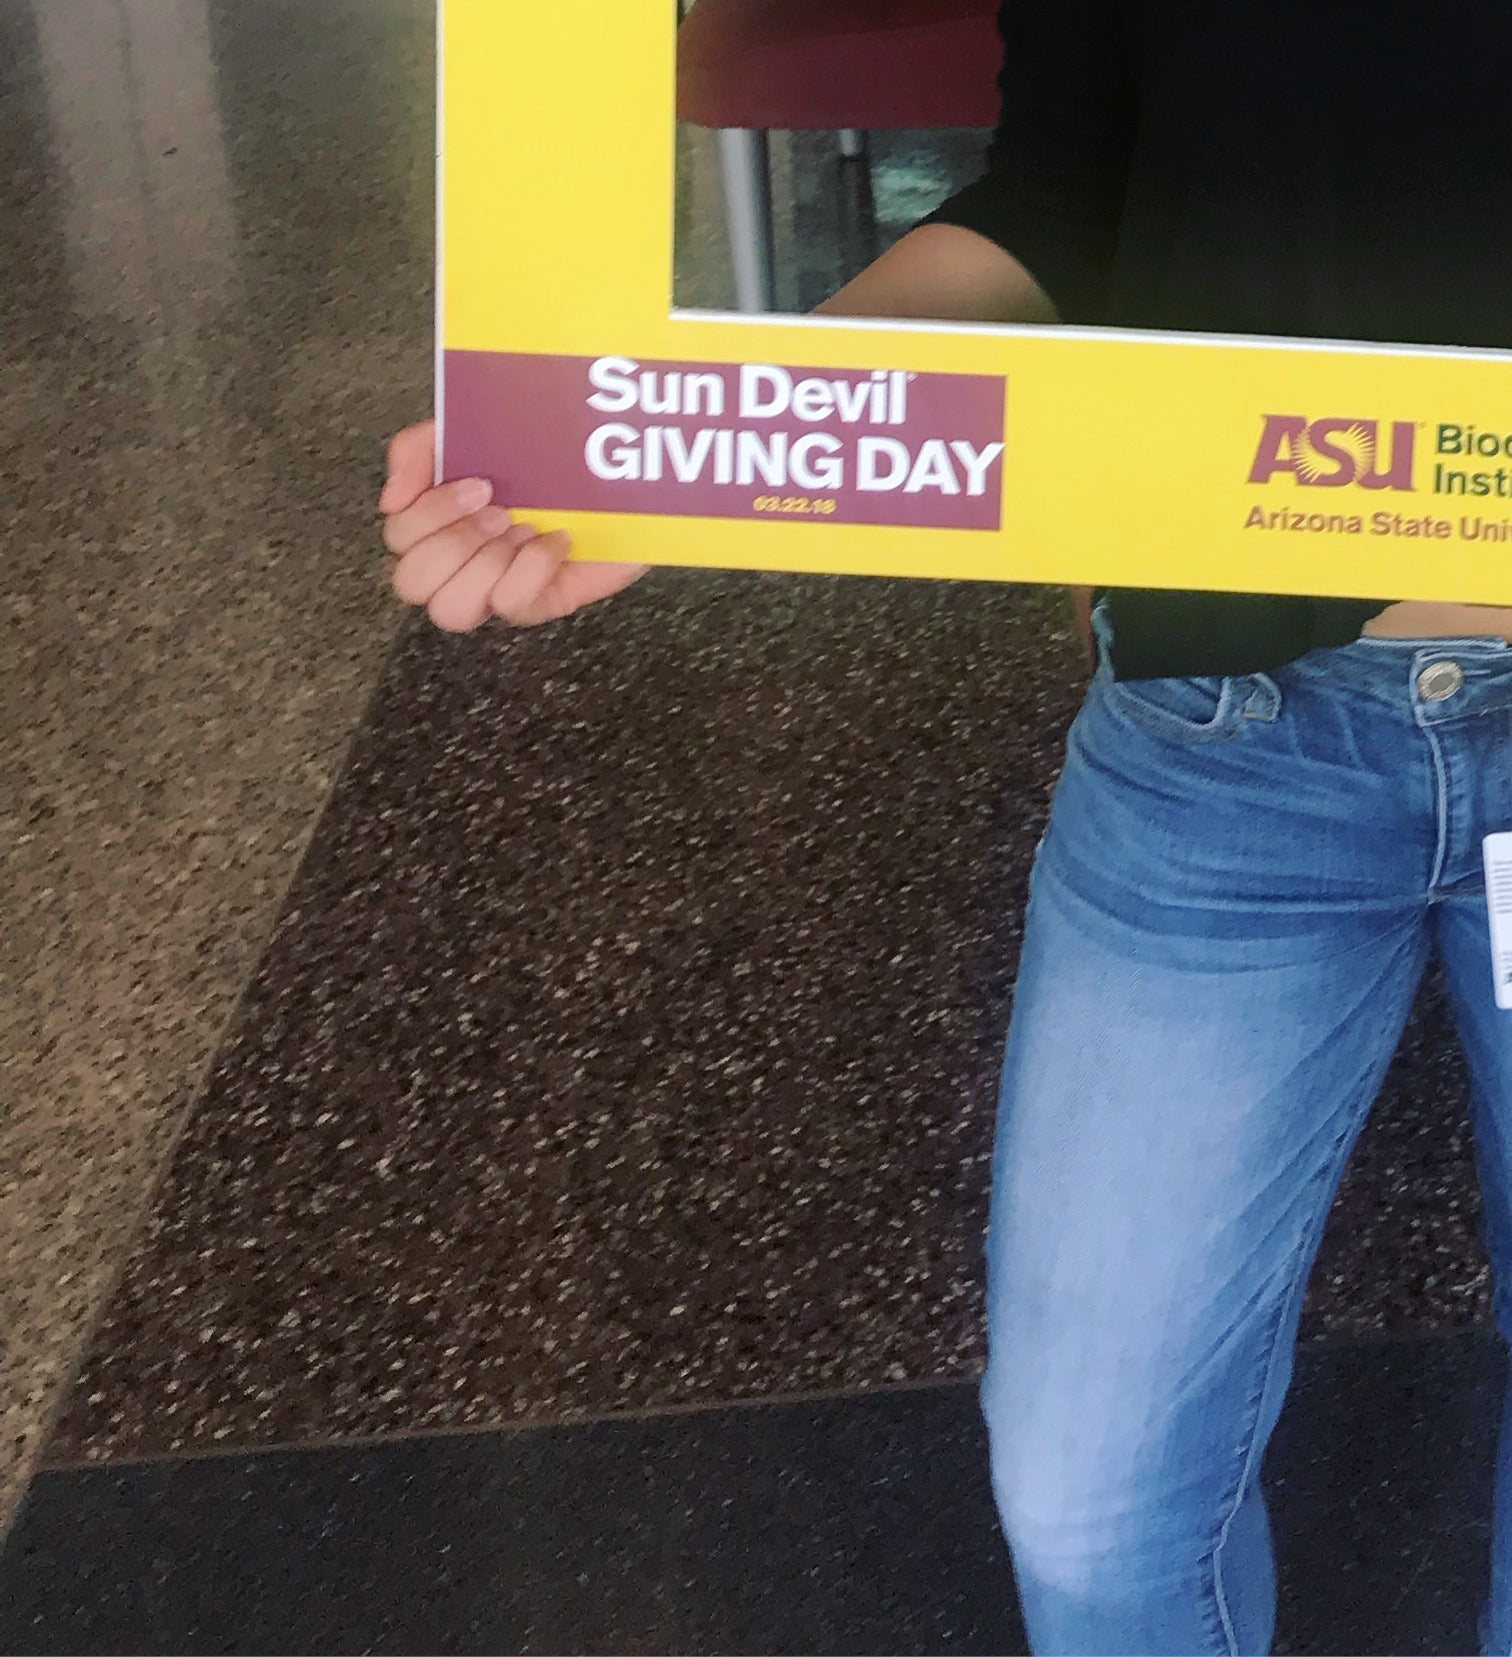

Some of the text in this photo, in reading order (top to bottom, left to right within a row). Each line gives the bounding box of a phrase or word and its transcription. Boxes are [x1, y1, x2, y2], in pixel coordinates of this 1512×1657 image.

[586, 355, 725, 416] Sun
[584, 422, 1008, 497] GIVING DAY
[1247, 414, 1417, 492] ASU
[1244, 504, 1363, 535] Arizona
[1370, 510, 1452, 541] State
